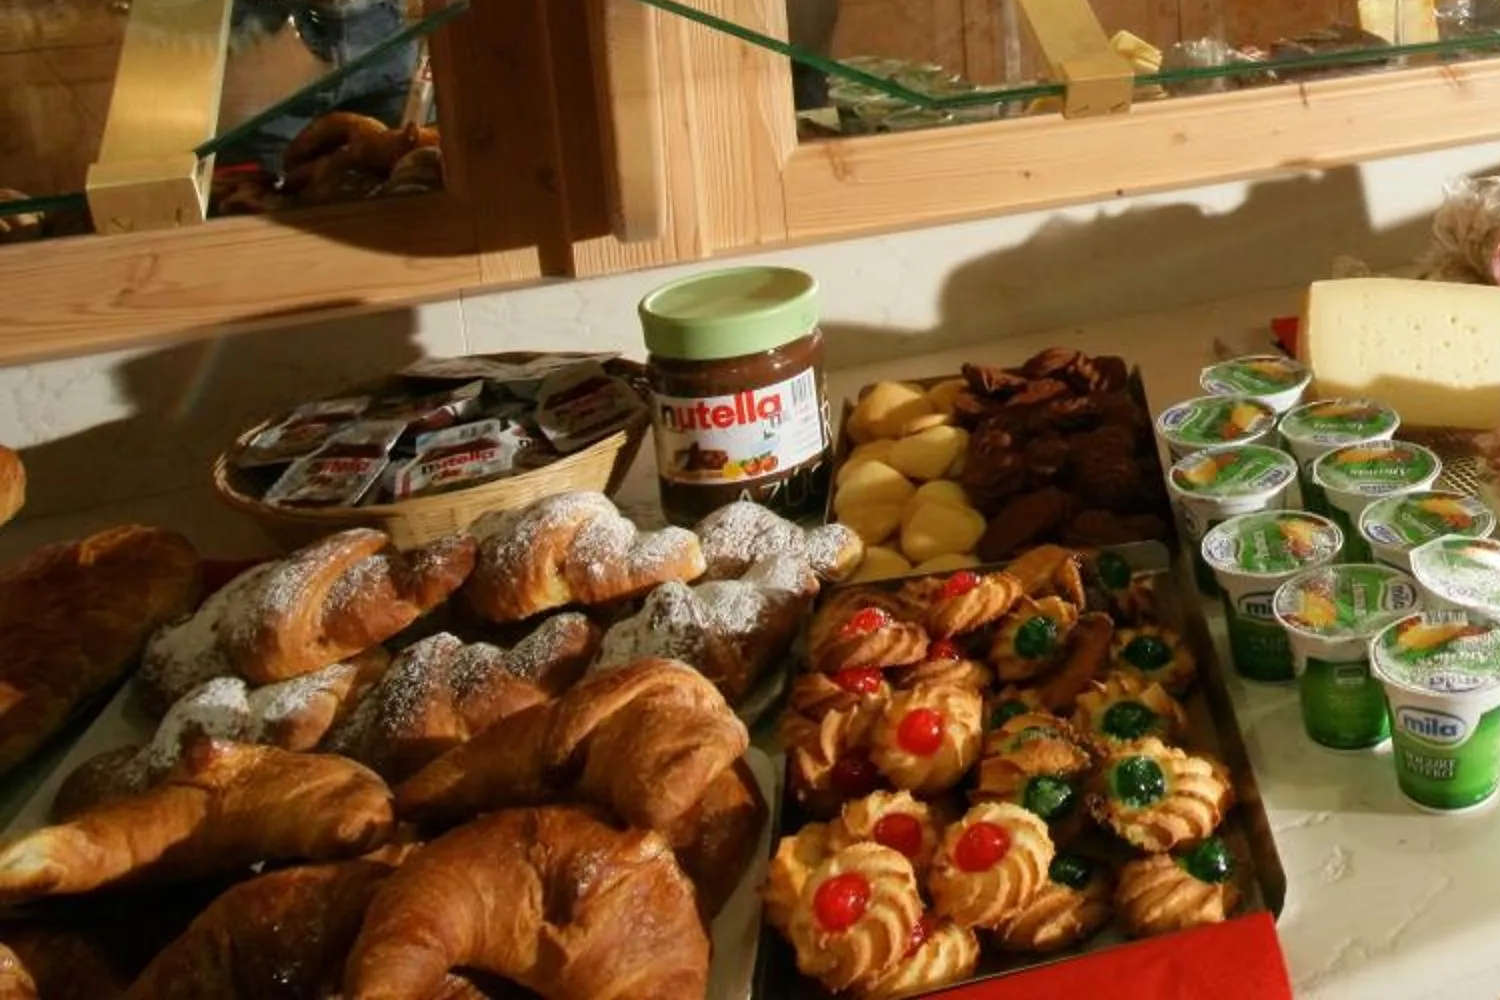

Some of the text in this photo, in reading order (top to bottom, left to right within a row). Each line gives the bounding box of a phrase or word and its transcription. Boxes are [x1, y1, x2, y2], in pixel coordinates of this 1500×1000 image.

[661, 390, 783, 432] nutella
[421, 449, 495, 475] nutella
[1403, 713, 1458, 738] mila
